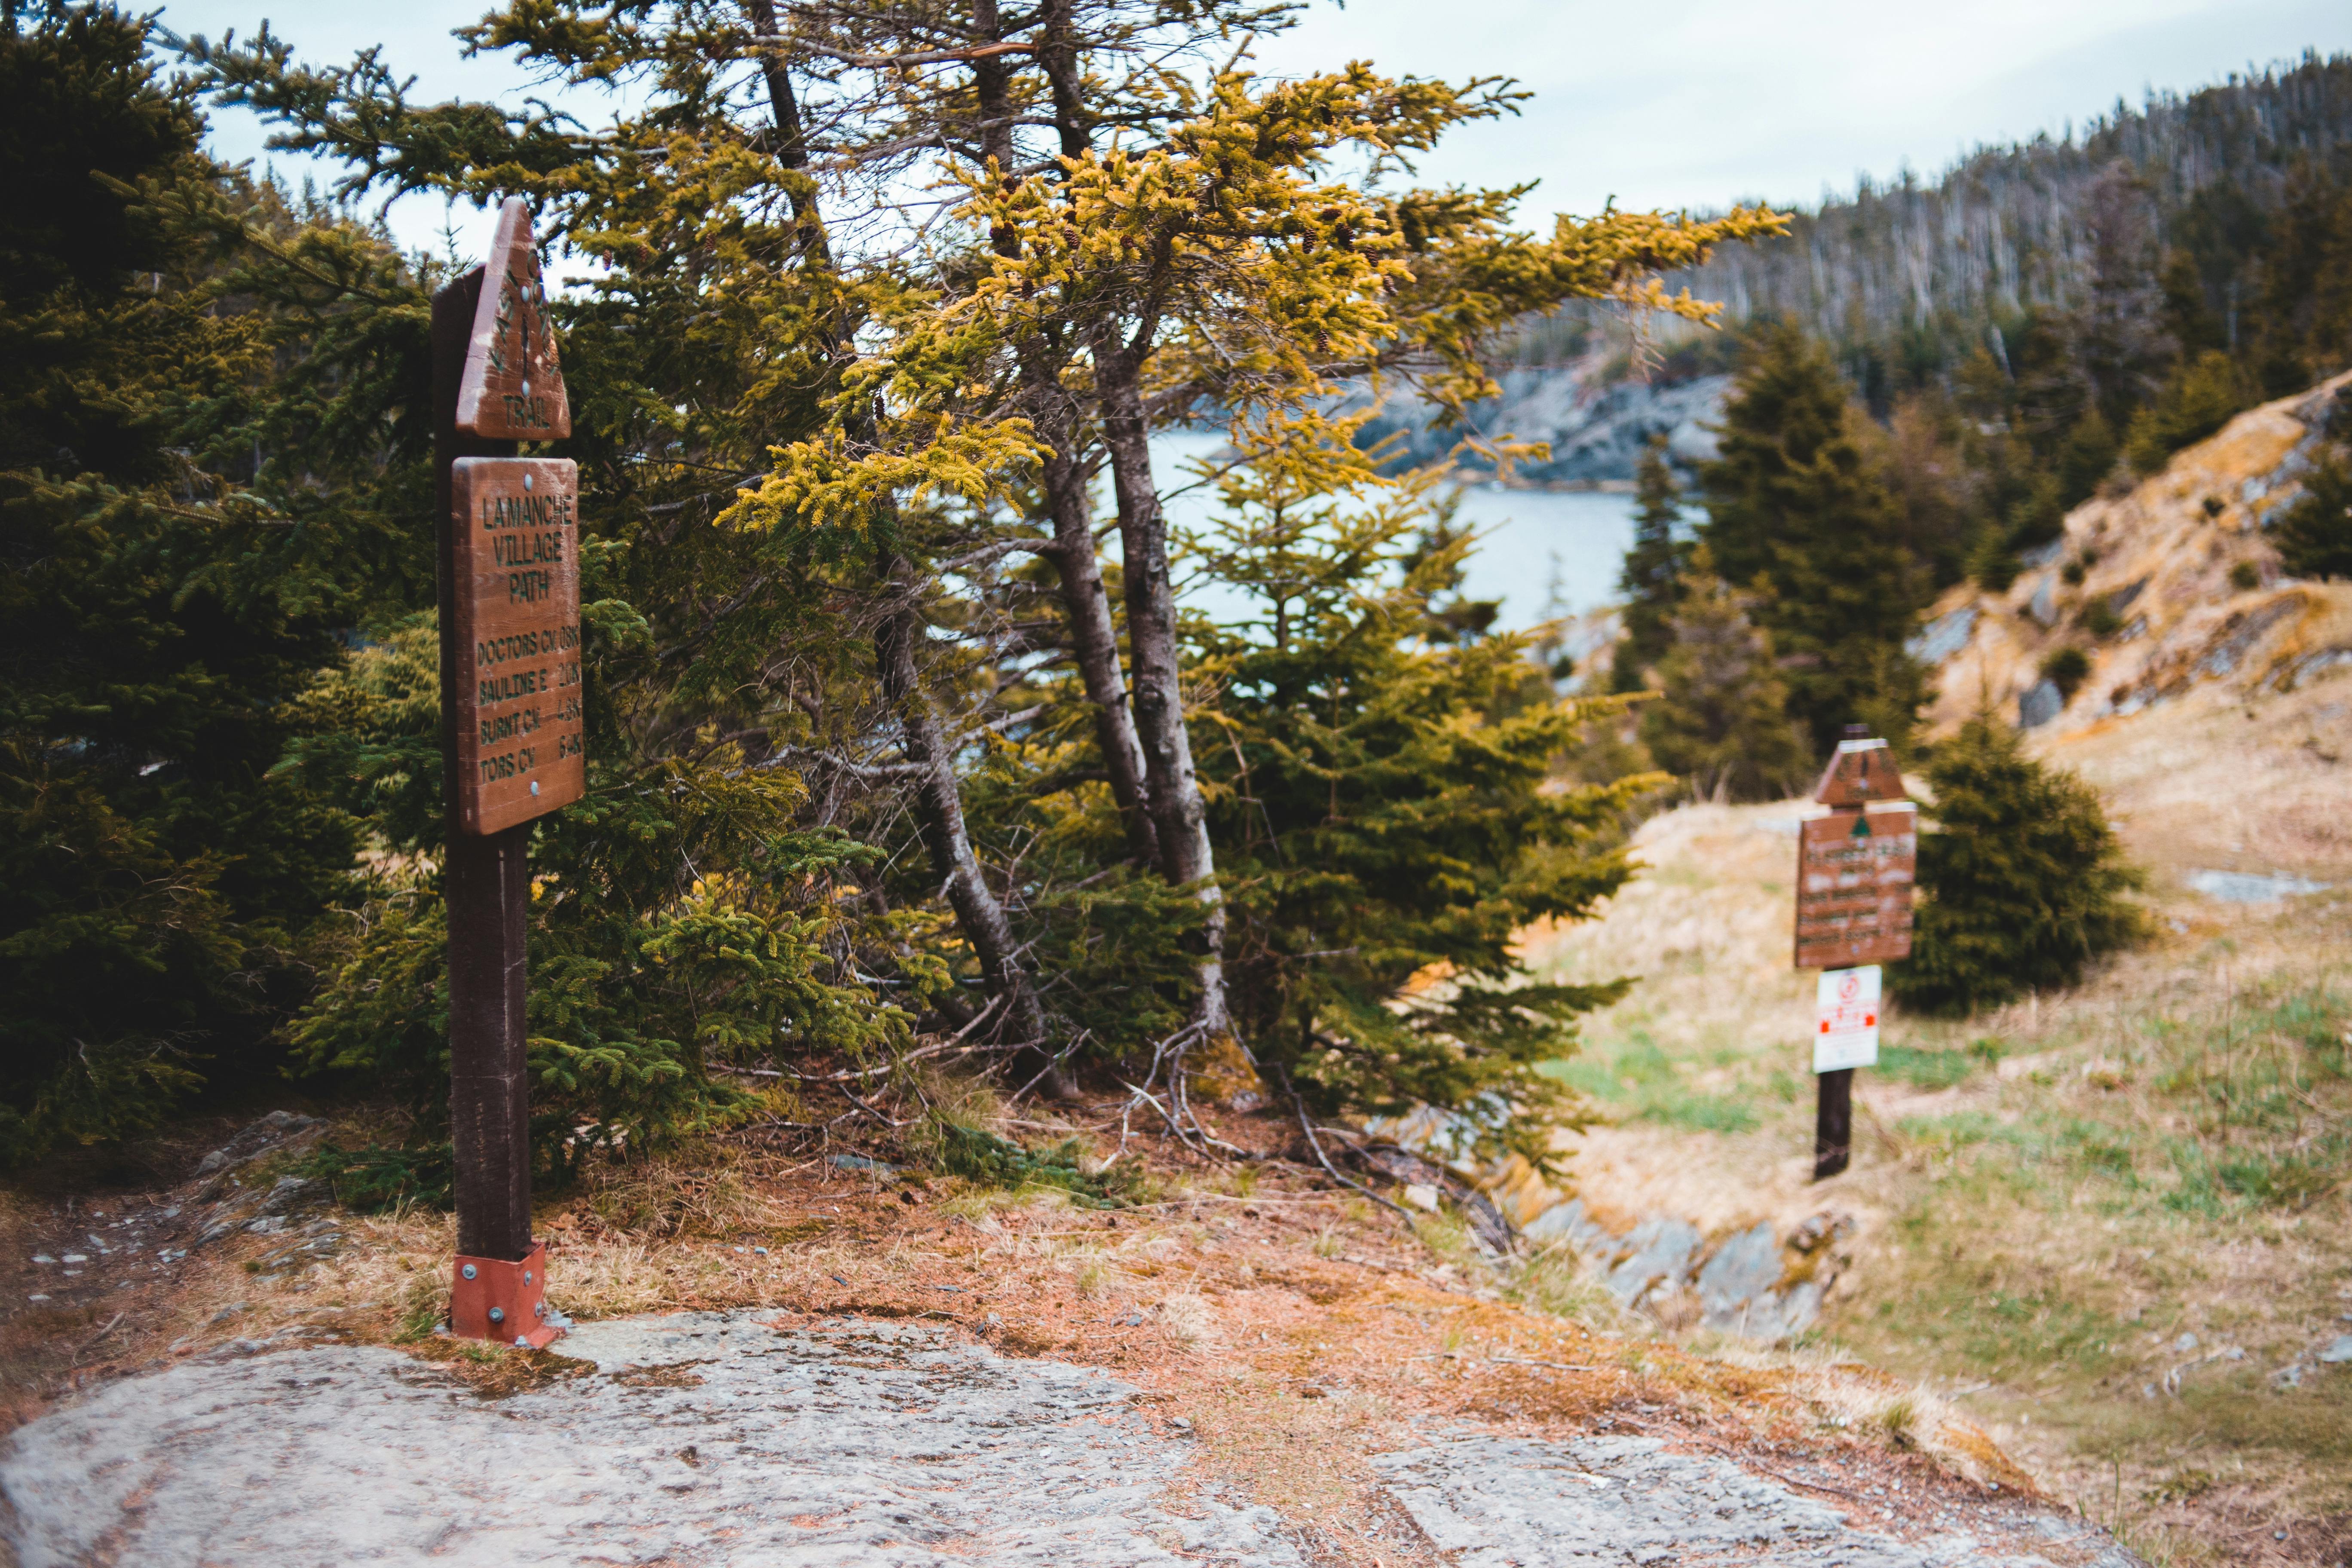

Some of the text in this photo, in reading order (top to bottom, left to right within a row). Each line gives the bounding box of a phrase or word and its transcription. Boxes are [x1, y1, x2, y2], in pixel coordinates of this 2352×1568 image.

[503, 395, 550, 429] TRAIL
[483, 495, 572, 530] LAMANCHE
[493, 532, 562, 567] VILLAGE
[509, 570, 549, 605] PATH
[478, 631, 537, 667] DOCTORS
[480, 671, 536, 706] BAULINE
[539, 668, 547, 692] E
[481, 712, 521, 745] BURNT
[480, 753, 514, 785] TORS
